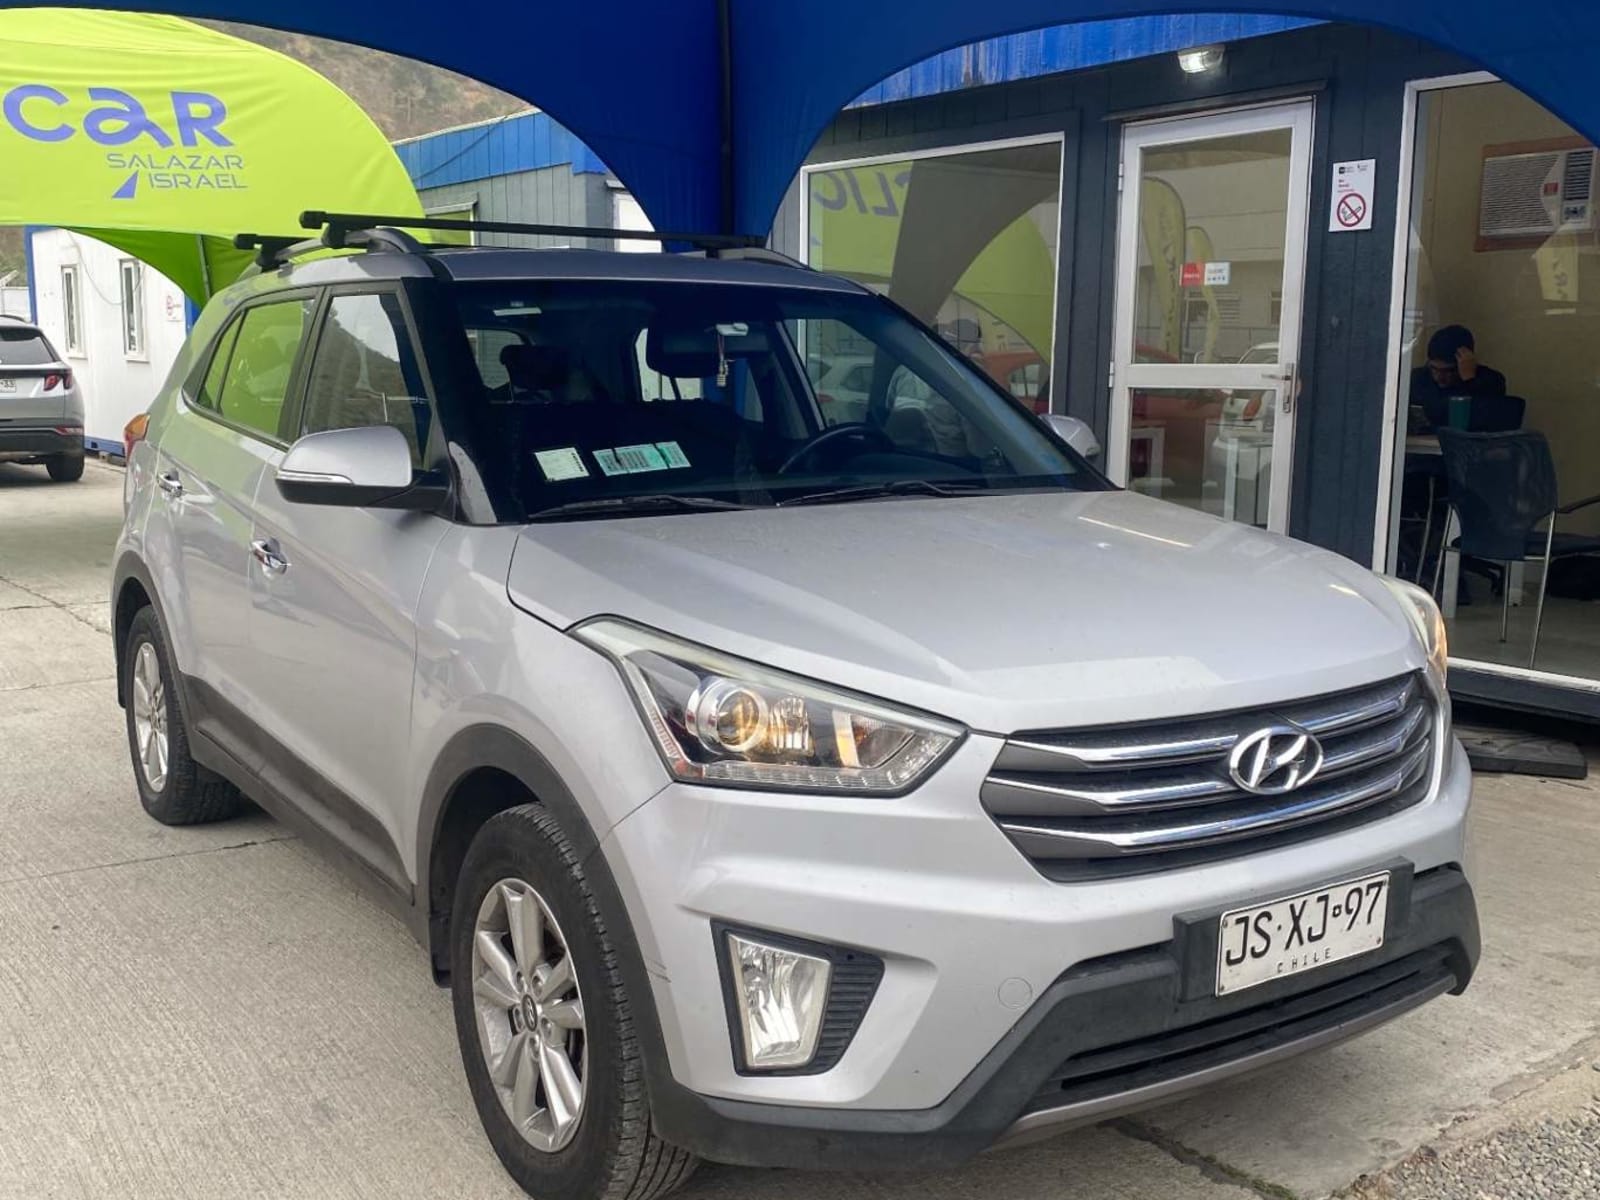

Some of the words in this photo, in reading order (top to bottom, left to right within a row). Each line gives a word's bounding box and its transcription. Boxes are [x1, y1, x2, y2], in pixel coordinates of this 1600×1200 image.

[106, 153, 244, 170] SALAZAR
[150, 174, 248, 189] ISRAEL
[1277, 948, 1332, 974] CHILE
